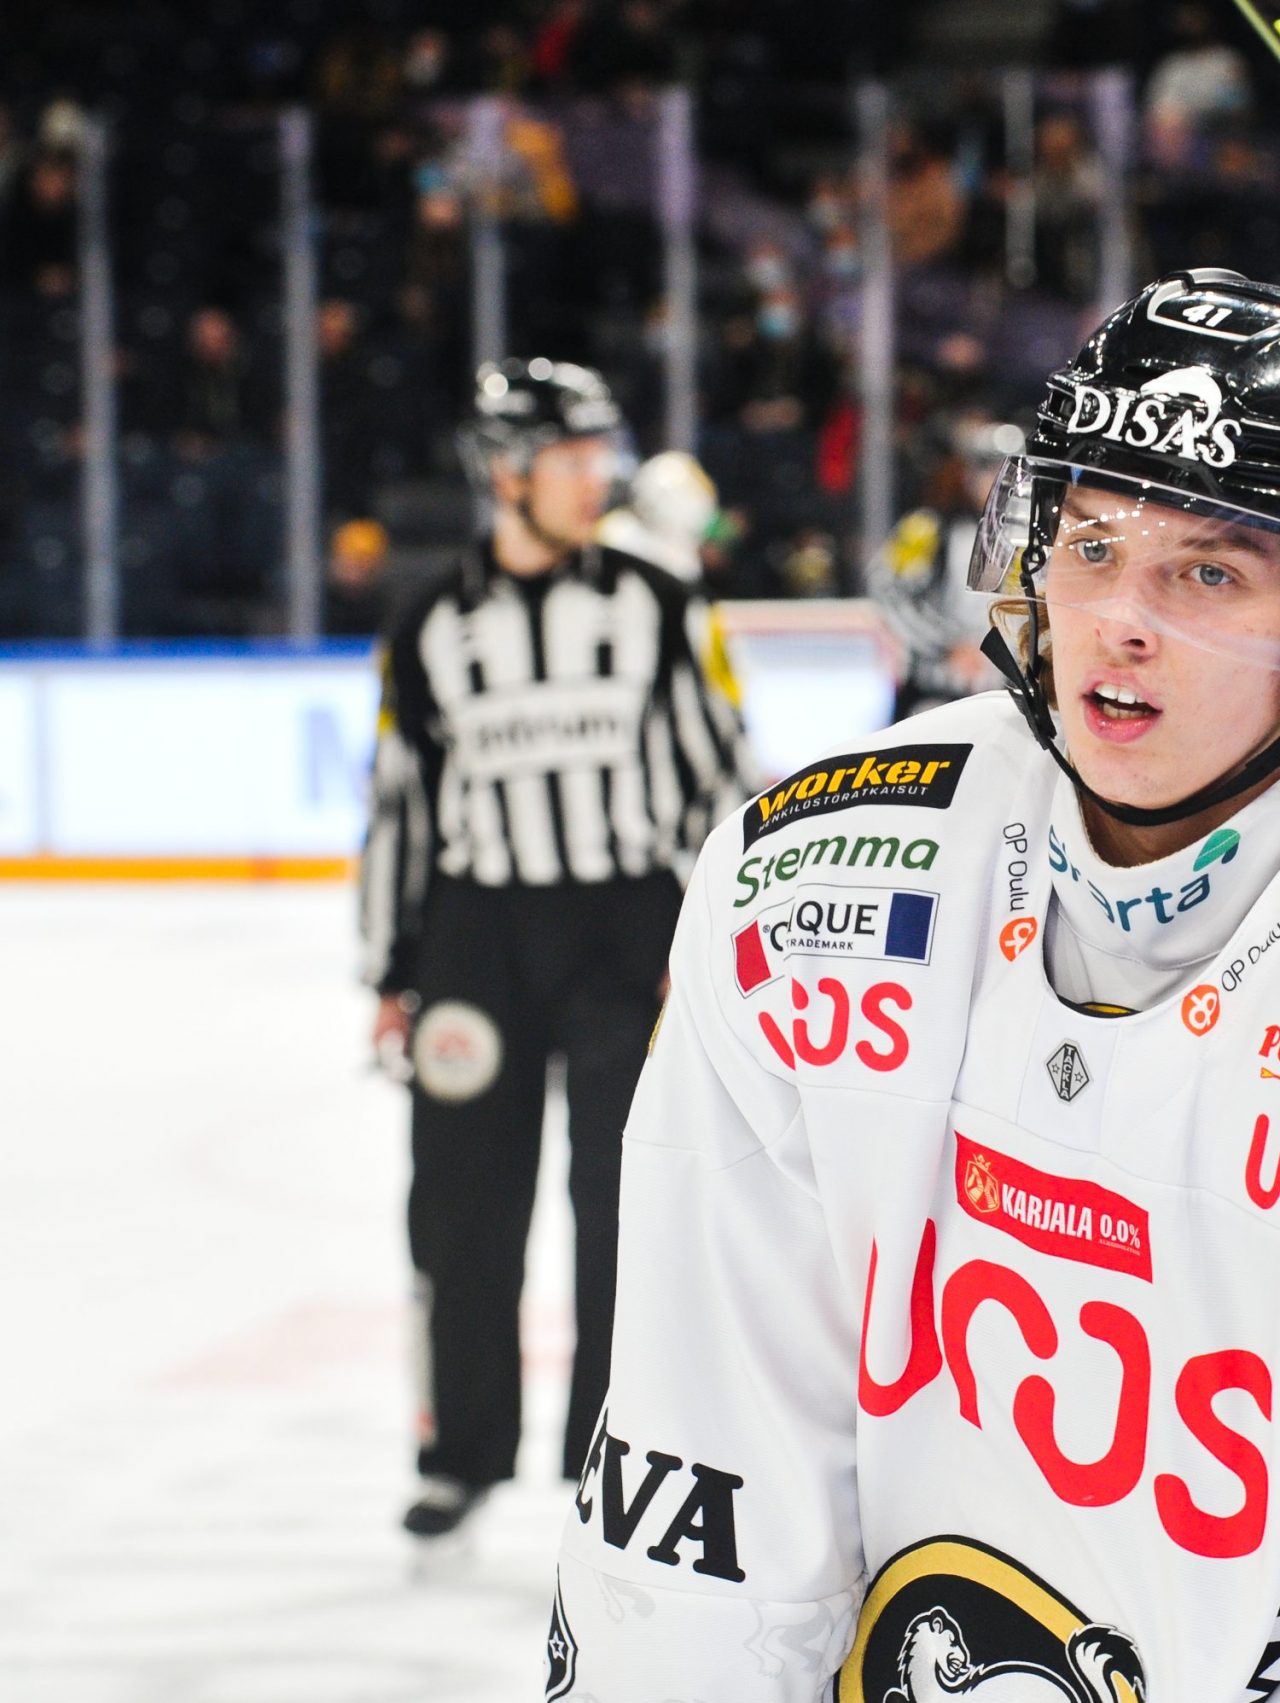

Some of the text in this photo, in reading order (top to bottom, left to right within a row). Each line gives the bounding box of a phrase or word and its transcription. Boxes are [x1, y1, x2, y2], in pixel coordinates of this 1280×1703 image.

[1181, 303, 1233, 328] 41
[1067, 385, 1242, 469] DISAS
[757, 756, 951, 822] worker
[732, 834, 941, 909] Stemma
[1002, 821, 1030, 913] OP Oulu
[1220, 958, 1246, 993] OP
[1060, 1045, 1076, 1099] TACKLA
[1001, 1183, 1093, 1242] KARJALA
[1098, 1212, 1142, 1250] 0.0%
